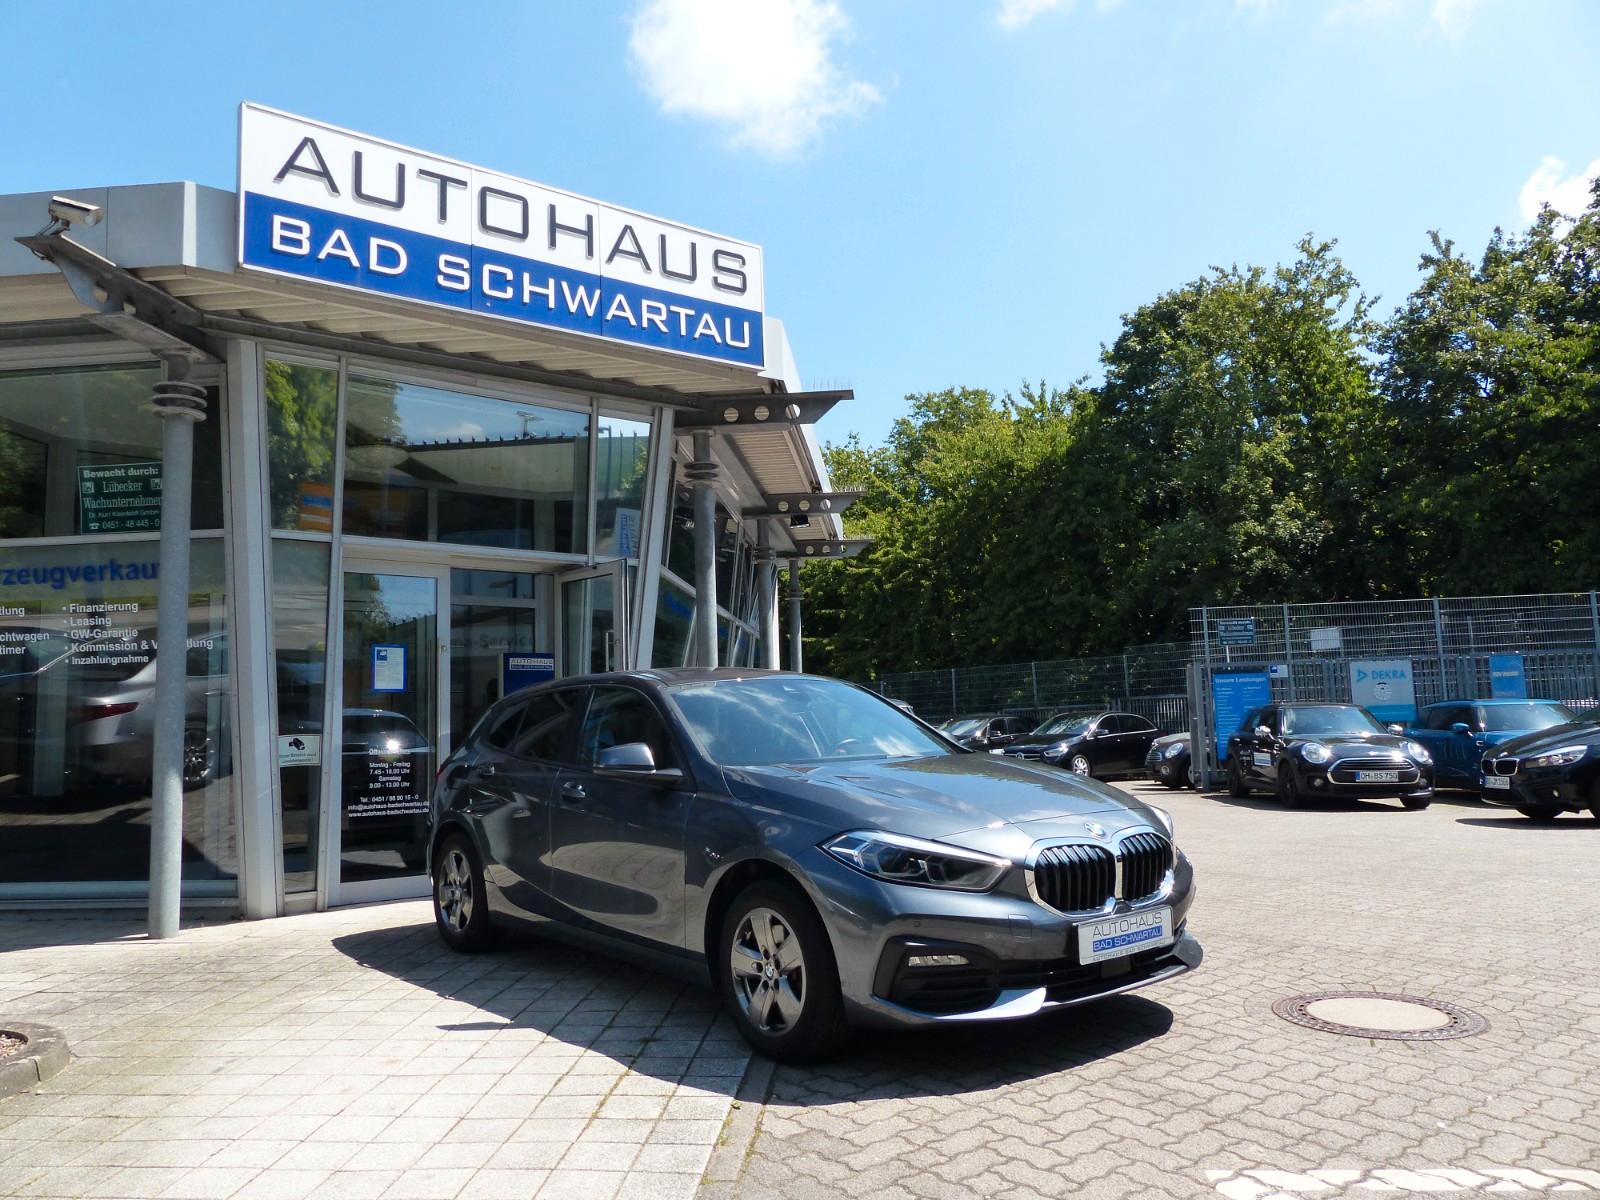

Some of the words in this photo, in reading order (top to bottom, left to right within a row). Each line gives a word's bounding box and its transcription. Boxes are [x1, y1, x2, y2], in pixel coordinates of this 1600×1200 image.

[273, 136, 748, 296] AUTOHAUS
[270, 213, 409, 276] BAD
[436, 252, 750, 350] SCHWARTAU
[83, 469, 126, 479] Bewacht
[128, 467, 160, 477] durch:
[103, 481, 144, 493] Lübecker
[102, 520, 119, 530] 0451
[0, 558, 160, 590] zeugverkau
[69, 602, 139, 613] Finanzierung
[70, 616, 112, 627] Leasing
[71, 628, 138, 639] GW-Garantie
[71, 640, 138, 652] Kommission
[140, 640, 149, 650] &
[72, 654, 149, 666] Inzahlungnahme
[1371, 670, 1406, 680] DEKRA
[1093, 912, 1162, 938] AUTOHAUS
[1094, 939, 1112, 950] BAD
[1114, 926, 1162, 947] SCHWARTAU
